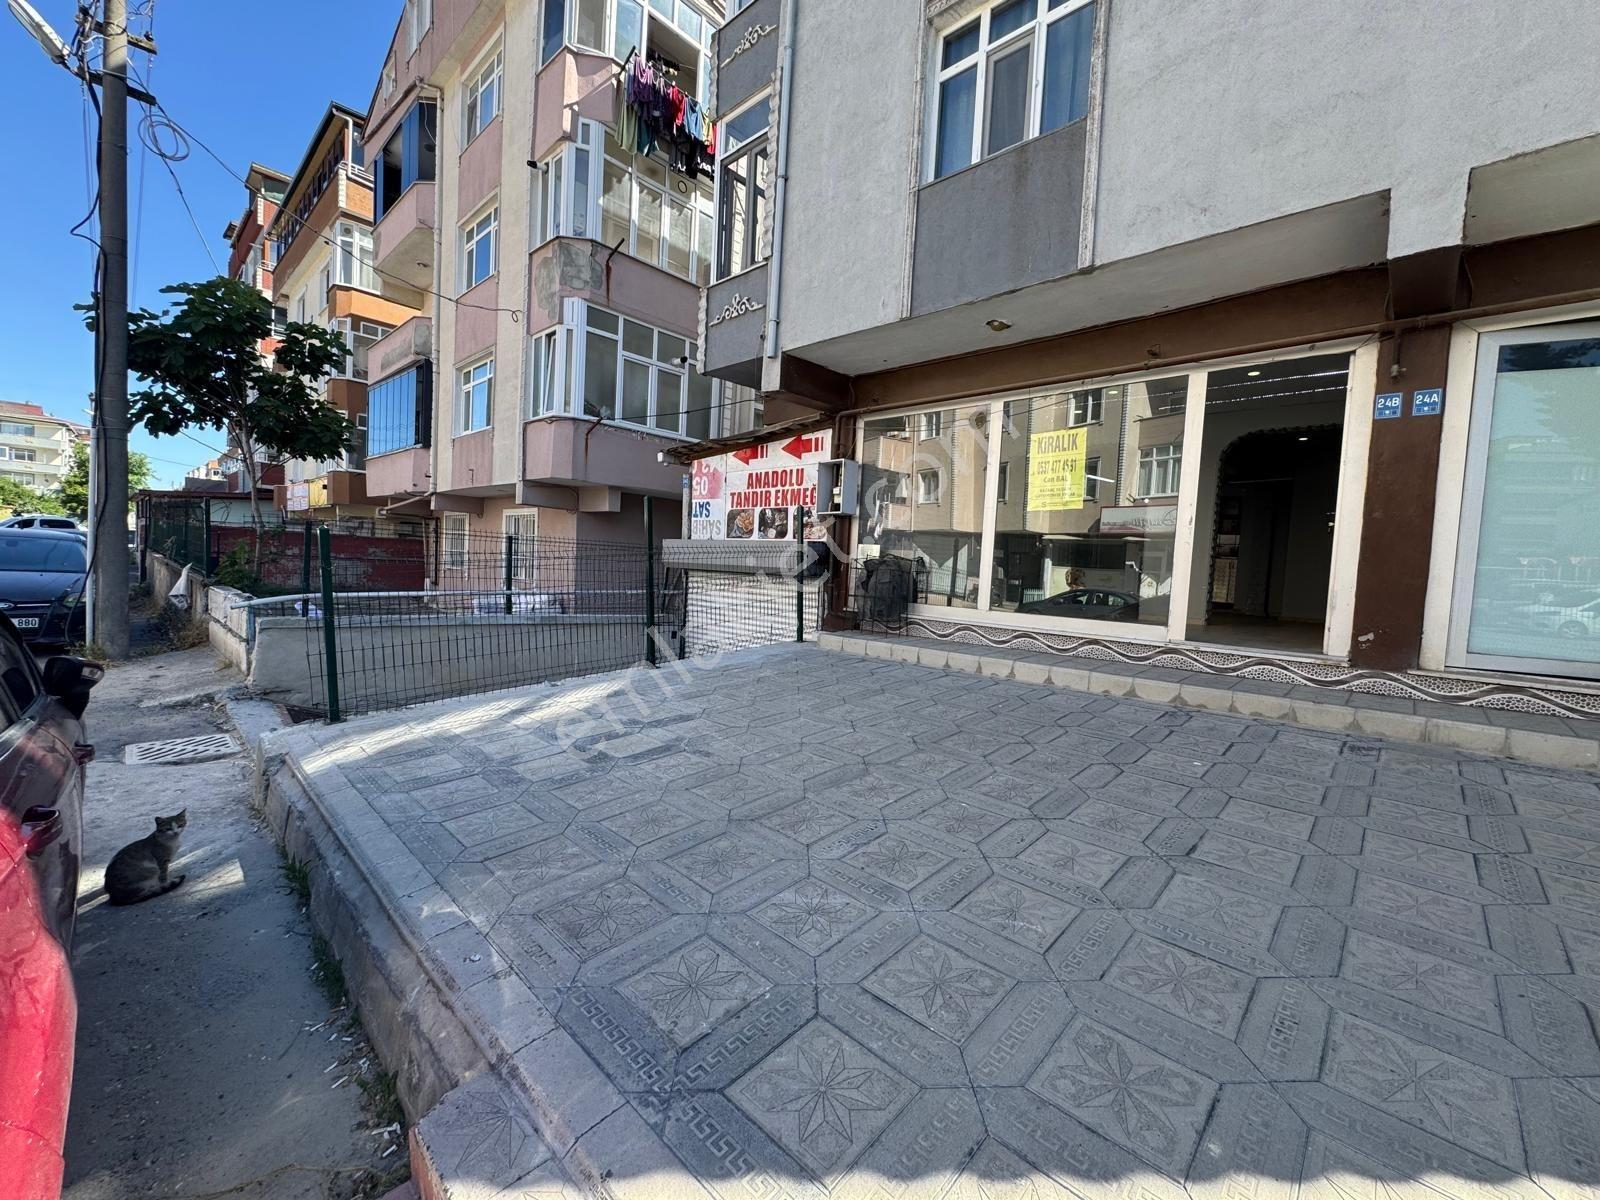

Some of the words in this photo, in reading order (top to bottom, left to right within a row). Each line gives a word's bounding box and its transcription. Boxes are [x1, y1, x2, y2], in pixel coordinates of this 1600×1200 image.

[1377, 397, 1400, 407] 24B
[1416, 394, 1439, 404] 24A
[747, 468, 804, 489] ANADOLU
[730, 490, 772, 509] TANDIR
[18, 619, 37, 627] 880
